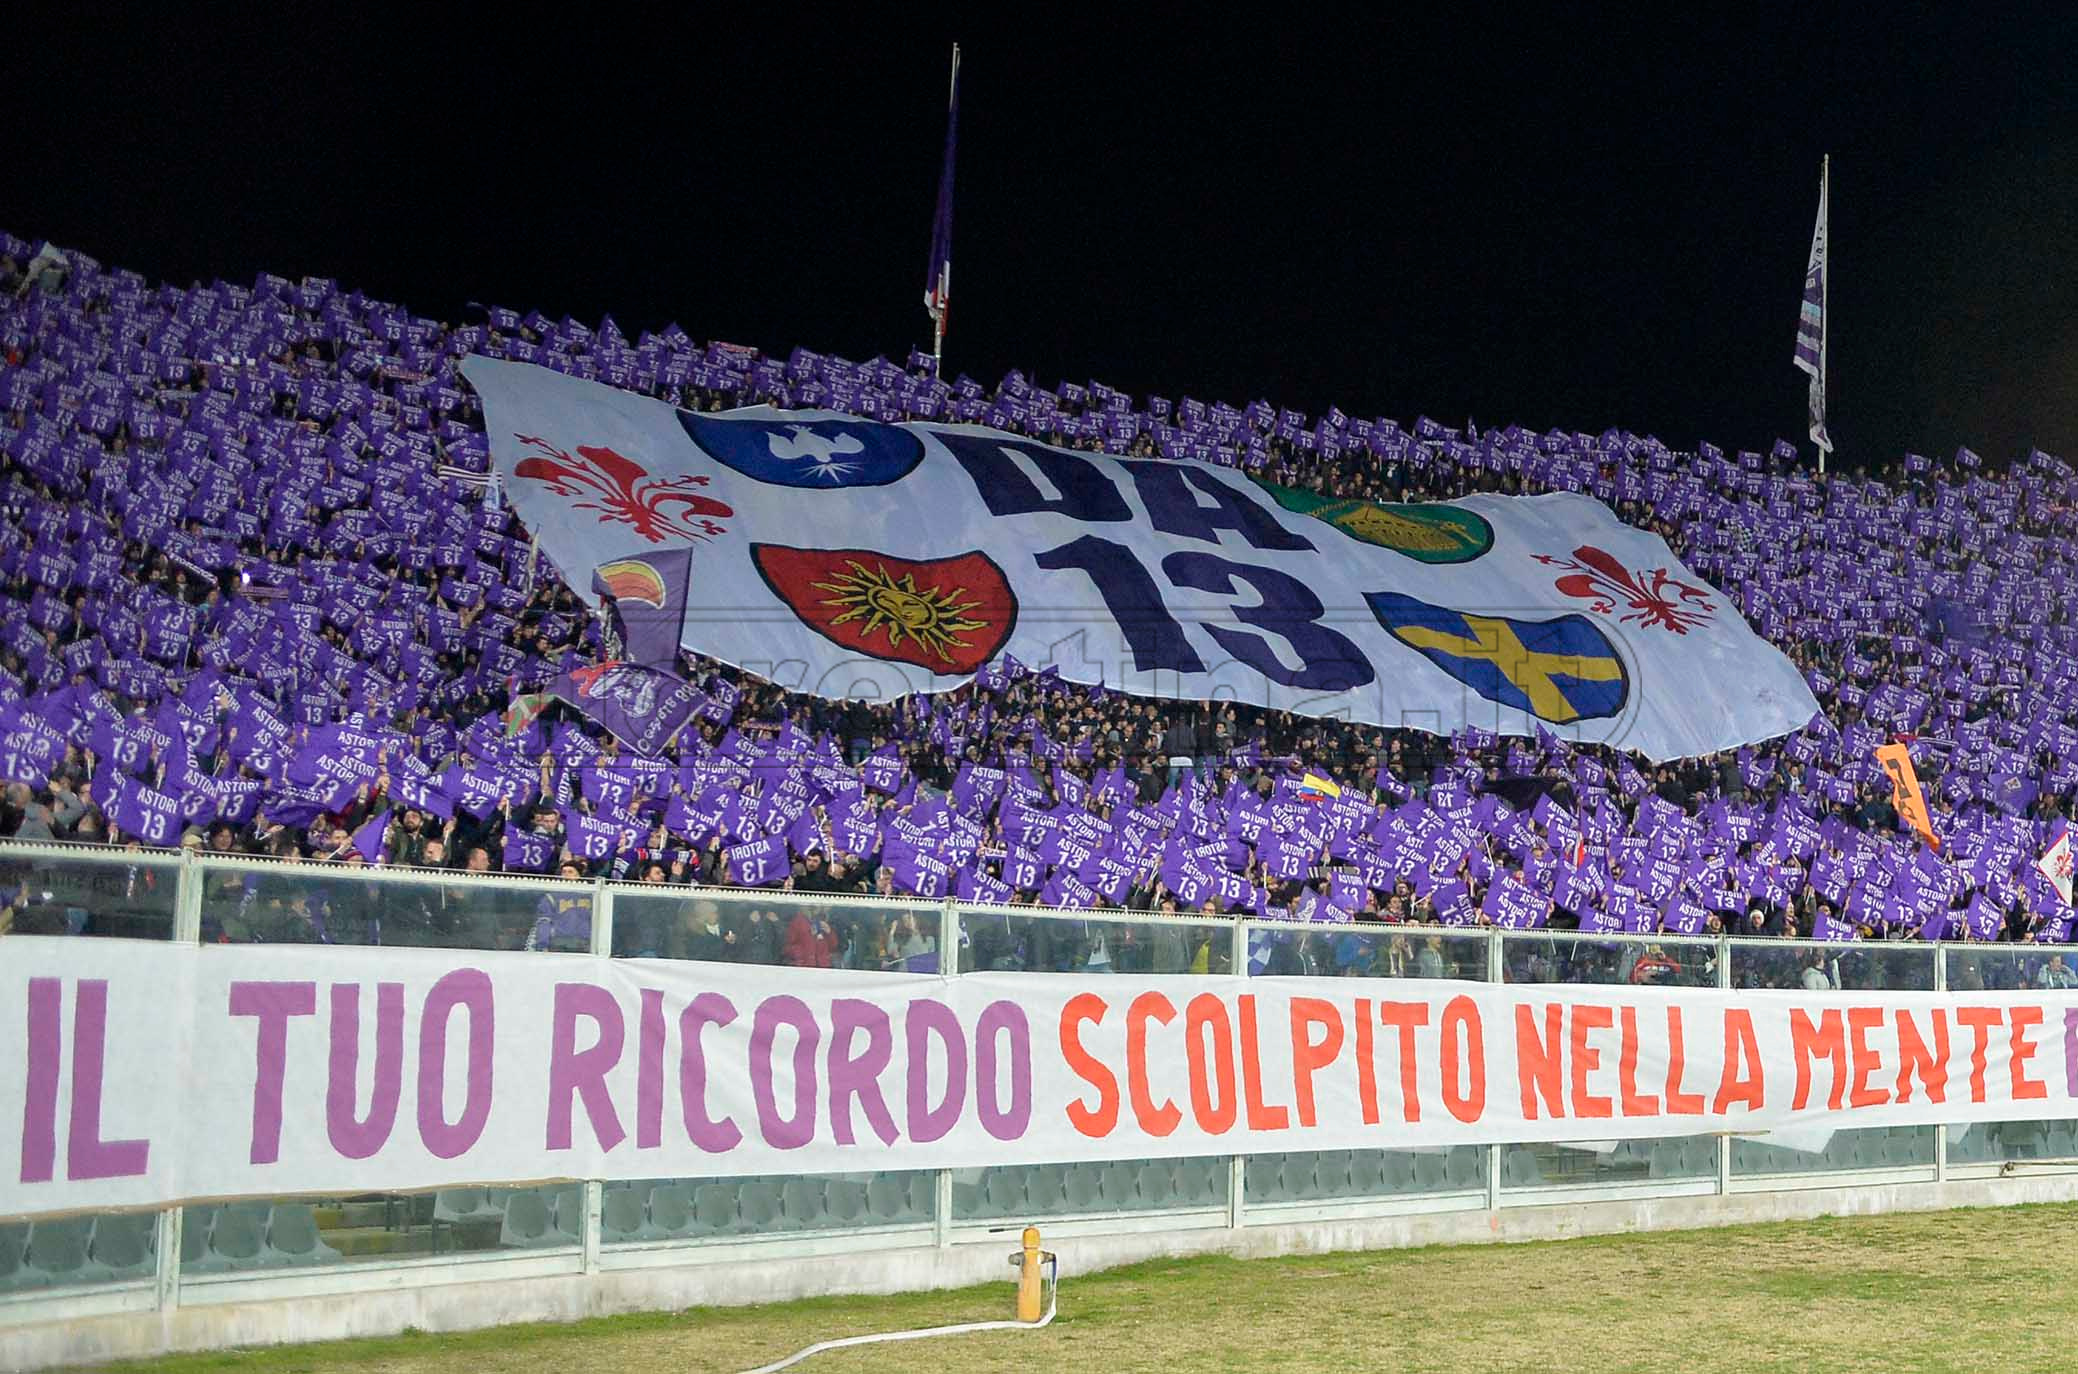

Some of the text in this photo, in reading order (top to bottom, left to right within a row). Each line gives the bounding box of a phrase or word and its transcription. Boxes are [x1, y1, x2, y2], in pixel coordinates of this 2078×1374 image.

[501, 316, 514, 328] 13
[919, 356, 930, 368] 13
[801, 390, 814, 402] 13
[1067, 389, 1079, 400] 13
[1096, 386, 1108, 400] 13
[1156, 403, 1168, 414] 13
[1332, 413, 1344, 427] 13
[1523, 435, 1535, 446] 13
[1746, 457, 1758, 468] 13
[930, 431, 1320, 554] DA
[410, 554, 426, 567] 13
[161, 613, 183, 628] 13
[293, 614, 312, 628] 13
[1034, 534, 1374, 692] 13
[1860, 606, 1873, 617] 13
[159, 631, 188, 642] ASTORI
[387, 631, 404, 646] 13
[161, 639, 179, 657] 13
[1902, 641, 1913, 652] 13
[1817, 682, 1828, 692] 13
[252, 707, 287, 737] ASTORI
[305, 707, 322, 723] 13
[114, 737, 138, 763] 13
[338, 732, 378, 749] ASTORI
[567, 728, 600, 756] ASTORI
[1795, 747, 1809, 759] 13
[5, 752, 36, 780] 13
[316, 754, 358, 783] ASTORI
[340, 756, 377, 777] ASTORI
[632, 758, 666, 771] ASTORI
[871, 756, 900, 770] ASTORI
[2011, 760, 2024, 773] 13
[873, 770, 892, 786] 13
[971, 766, 1004, 780] ASTORI
[1060, 770, 1084, 787] ASTORI
[310, 773, 340, 803] 13
[462, 772, 500, 797] ASTORI
[494, 776, 516, 798] 13
[636, 775, 658, 793] 13
[1062, 784, 1077, 801] 13
[138, 788, 178, 814] ASTORI
[601, 784, 623, 804] 13
[1835, 789, 1848, 801] 13
[217, 796, 244, 816] 13
[771, 792, 801, 821] ASTORI
[1332, 802, 1359, 818] ASTORI
[142, 810, 166, 840] 13
[580, 816, 614, 835] ASTORI
[765, 810, 786, 834] 13
[953, 814, 982, 837] ASTORI
[1020, 812, 1058, 828] ASTORI
[1066, 813, 1096, 840] ASTORI
[1082, 813, 1112, 833] ASTORI
[1126, 809, 1160, 829] ASTORI
[1191, 816, 1208, 836] 13
[1271, 804, 1296, 831] ASTORI
[1726, 816, 1750, 826] ASTORI
[685, 820, 708, 840] 13
[737, 816, 756, 842] 13
[1022, 826, 1046, 846] 13
[1241, 823, 1260, 839] 13
[1298, 826, 1324, 849] ASTORI
[1320, 822, 1335, 841] 13
[1731, 826, 1748, 841] 13
[1784, 825, 1810, 844] ASTORI
[584, 835, 608, 857] 13
[847, 832, 868, 853] 13
[1279, 842, 1306, 857] ASTORI
[1434, 836, 1461, 860] ASTORI
[1786, 838, 1802, 854] 13
[1991, 843, 2018, 855] ASTORI
[522, 843, 542, 865] 13
[948, 849, 970, 868] 13
[1058, 851, 1081, 869] 13
[1432, 852, 1450, 872] 13
[1995, 853, 2011, 867] 13
[914, 854, 948, 876] ASTORI
[1014, 863, 1036, 886] 13
[1100, 856, 1132, 877] ASTORI
[1180, 862, 1208, 886] ASTORI
[1282, 855, 1300, 877] 13
[1394, 857, 1416, 877] 13
[1653, 859, 1680, 876] ASTORI
[915, 871, 936, 897] 13
[1098, 872, 1120, 895] 13
[1366, 867, 1384, 887] 13
[1566, 876, 1593, 896] ASTORI
[1650, 868, 1673, 888] ASTORI
[1876, 871, 1892, 886] 13
[1062, 875, 1092, 900] ASTORI
[1178, 876, 1198, 901] 13
[1219, 877, 1240, 898] 13
[1651, 882, 1666, 900] 13
[1765, 885, 1782, 900] 13
[1825, 882, 1840, 901] 13
[1916, 887, 1948, 901] ASTORI
[1058, 892, 1080, 912] 13
[1519, 892, 1547, 910] ASTORI
[1564, 892, 1582, 911] 13
[1613, 896, 1627, 915] 13
[1716, 895, 1736, 908] 13
[1442, 902, 1463, 927] 13
[1592, 913, 1622, 929] ASTORI
[1863, 908, 1882, 927] 13
[1898, 904, 1914, 922] 13
[1636, 914, 1650, 932] 13
[1678, 917, 1696, 932] 13
[1979, 916, 1994, 936] 13
[20, 977, 150, 1183] IL
[229, 967, 494, 1164] TUO
[546, 982, 1031, 1153] RICORDO
[1059, 991, 1485, 1138] SCOLPITO
[1515, 1003, 1764, 1120] NELLA
[1790, 1006, 2047, 1111] MENTE
